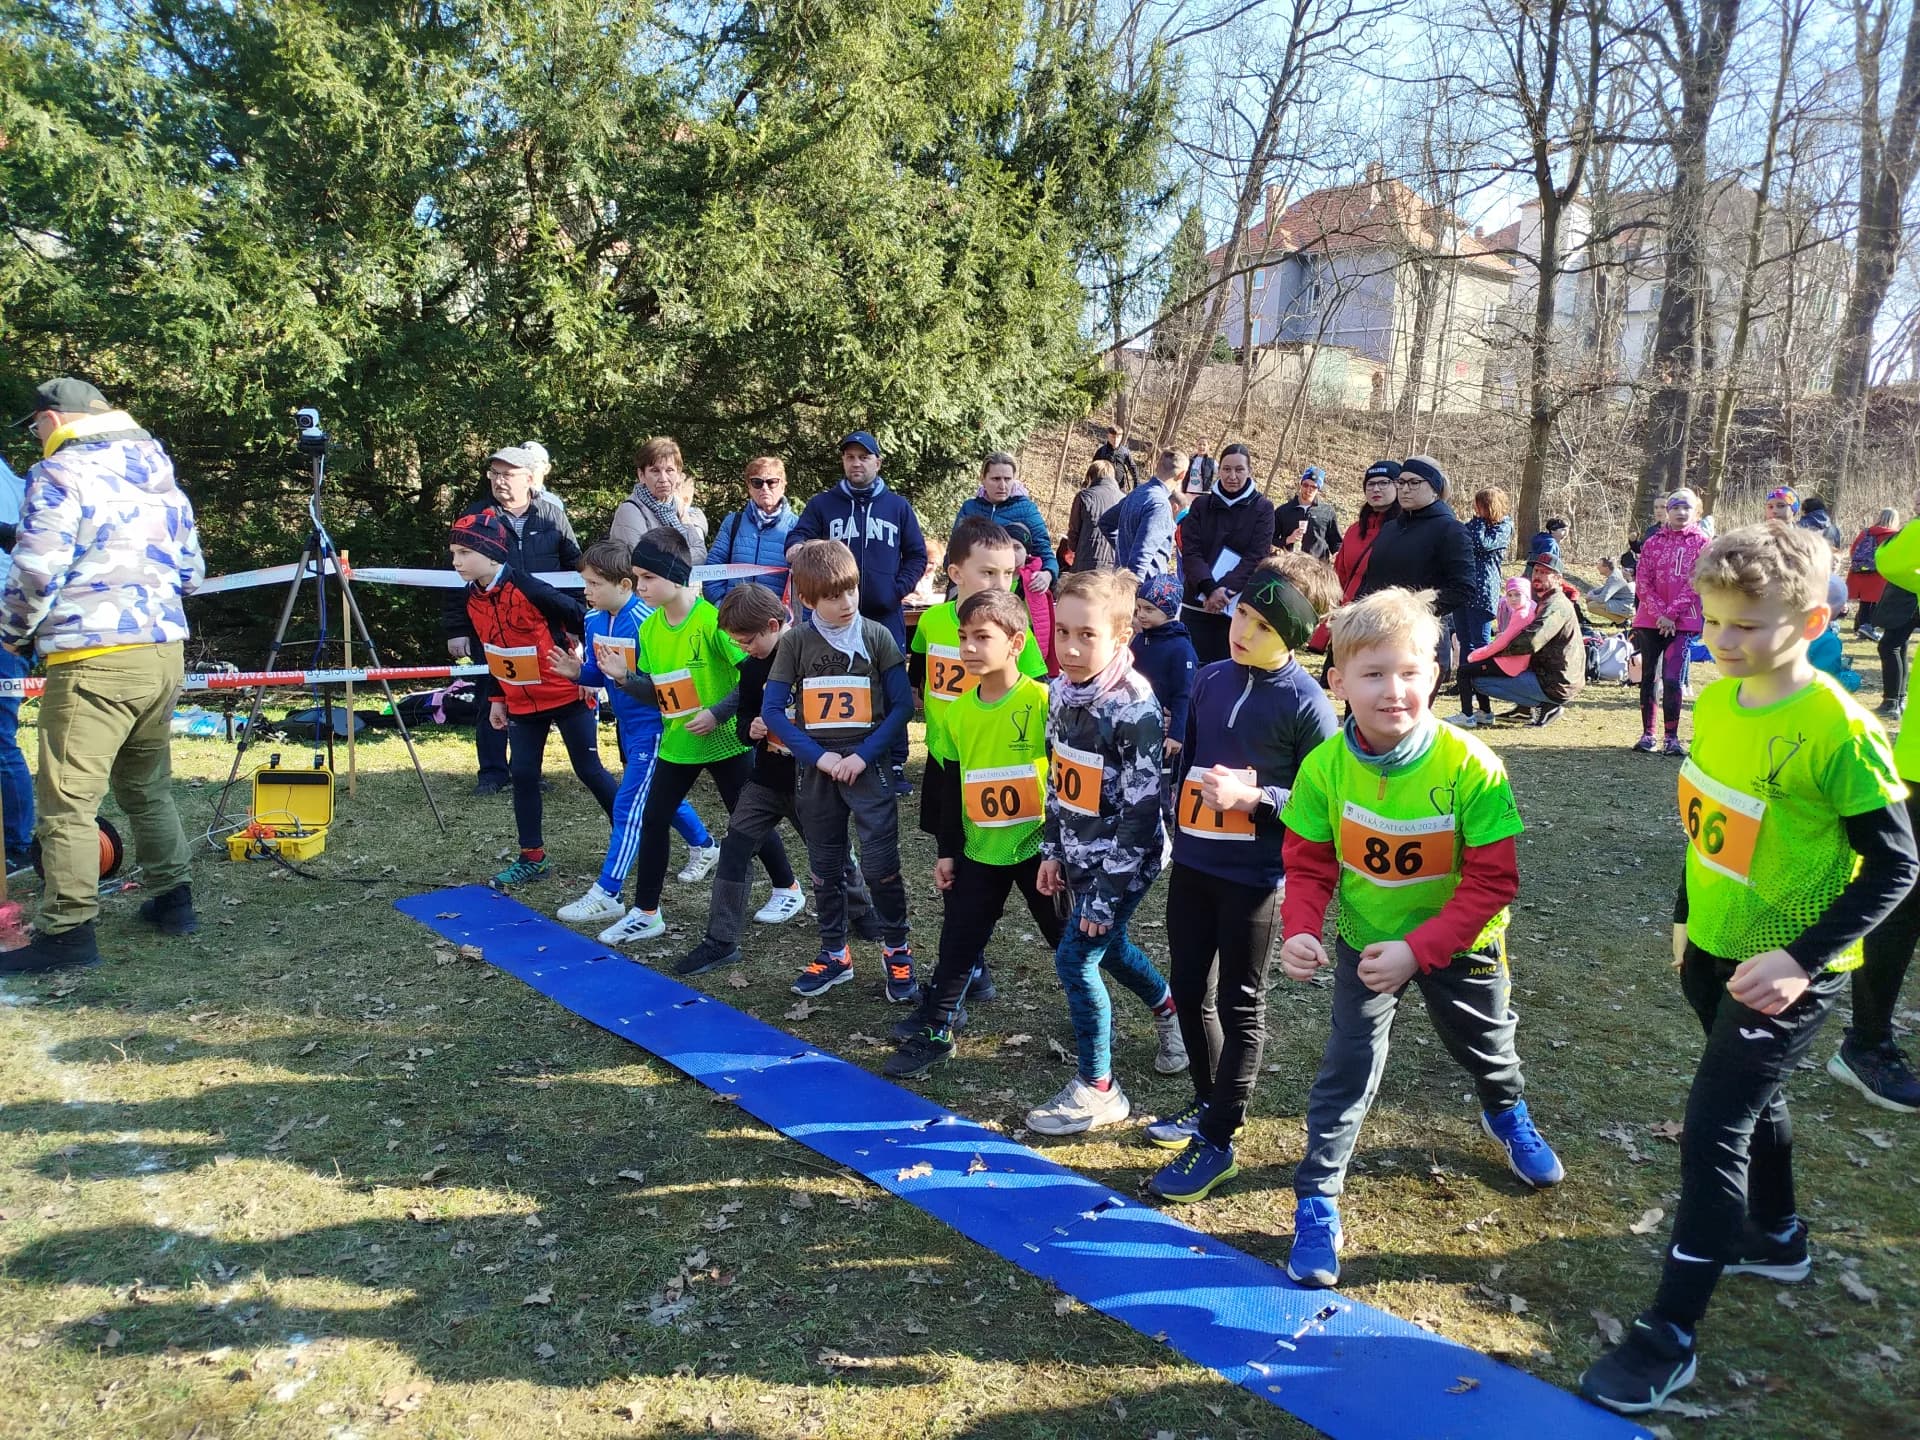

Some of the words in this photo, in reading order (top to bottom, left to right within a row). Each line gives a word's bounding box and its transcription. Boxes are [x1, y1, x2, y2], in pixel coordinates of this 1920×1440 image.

[830, 516, 898, 547] GANT
[503, 660, 517, 678] 3
[812, 654, 846, 671] ARM
[934, 662, 965, 693] 32
[657, 687, 681, 711] 41
[818, 692, 855, 719] 73
[981, 785, 1020, 817] 60
[1688, 797, 1727, 855] 66
[1363, 837, 1424, 875] 86
